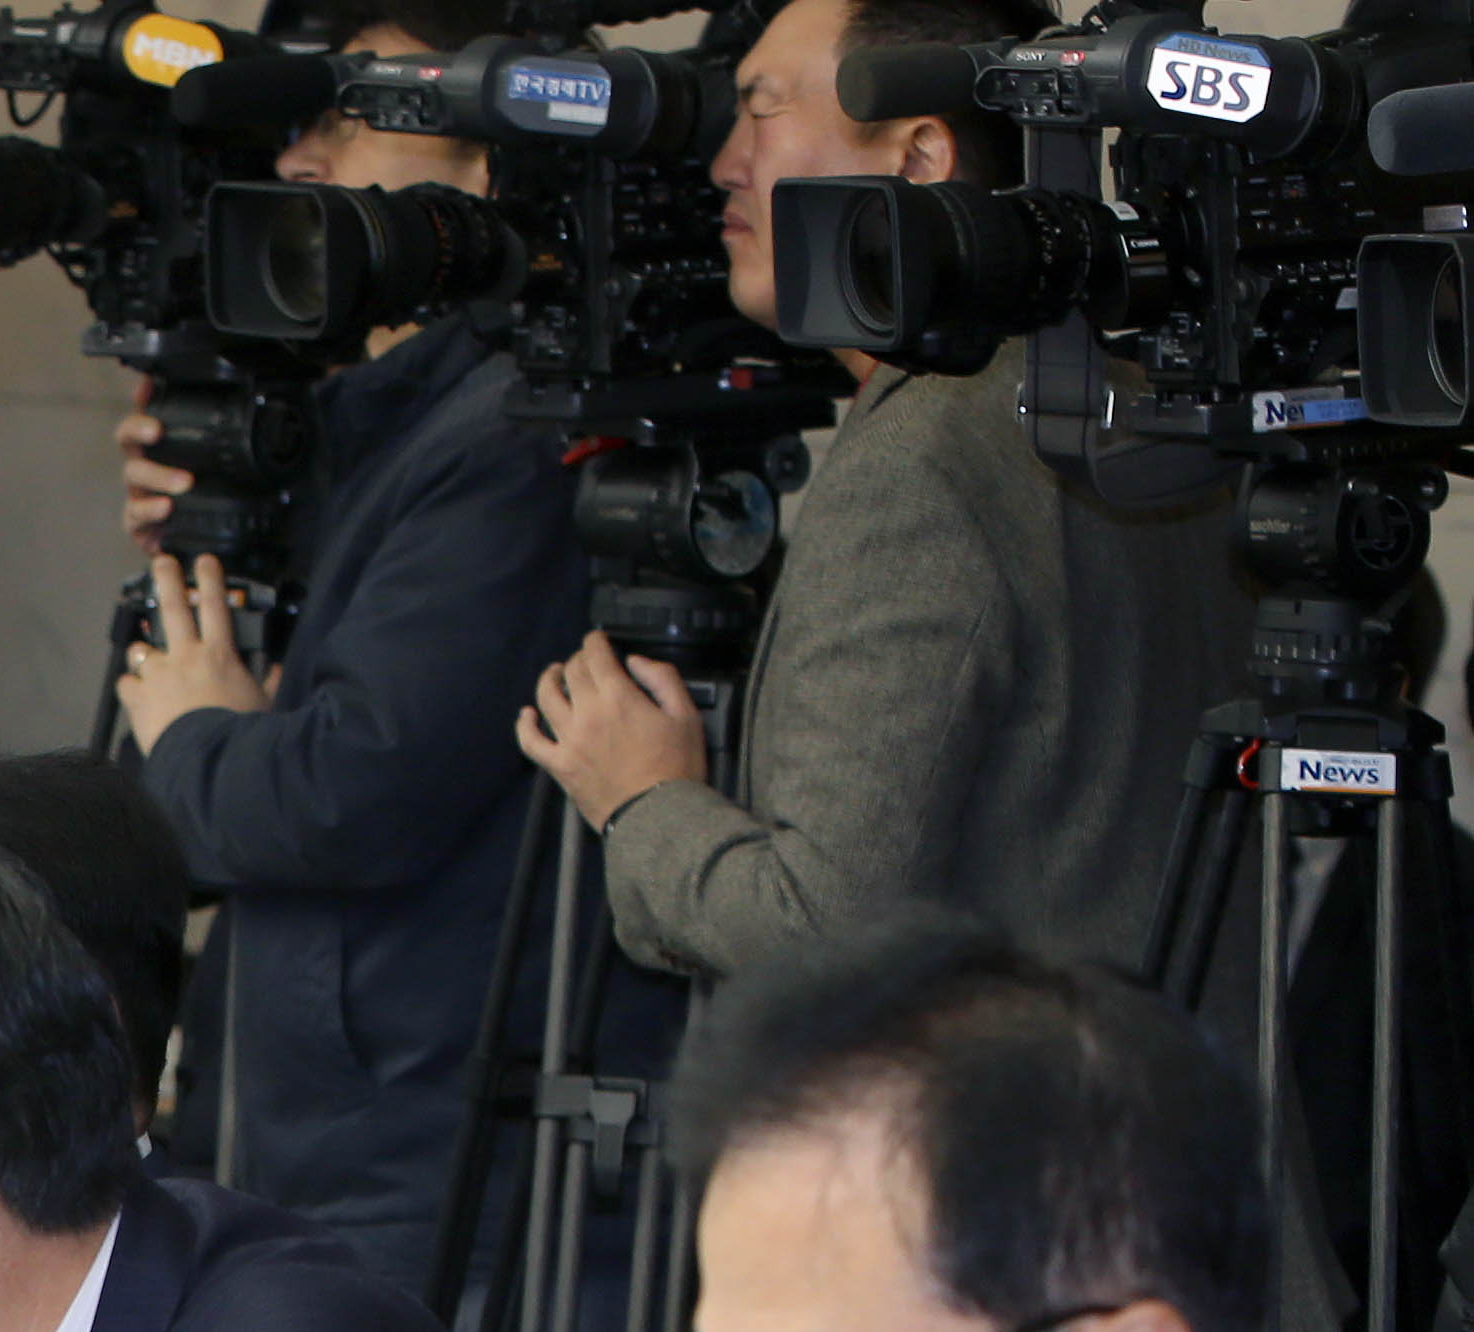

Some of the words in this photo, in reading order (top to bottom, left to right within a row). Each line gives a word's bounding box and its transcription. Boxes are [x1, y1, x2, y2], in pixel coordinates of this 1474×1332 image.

[133, 32, 216, 69] MBN
[1016, 52, 1045, 62] SONY
[1160, 60, 1254, 112] SBS
[1299, 759, 1381, 784] News
